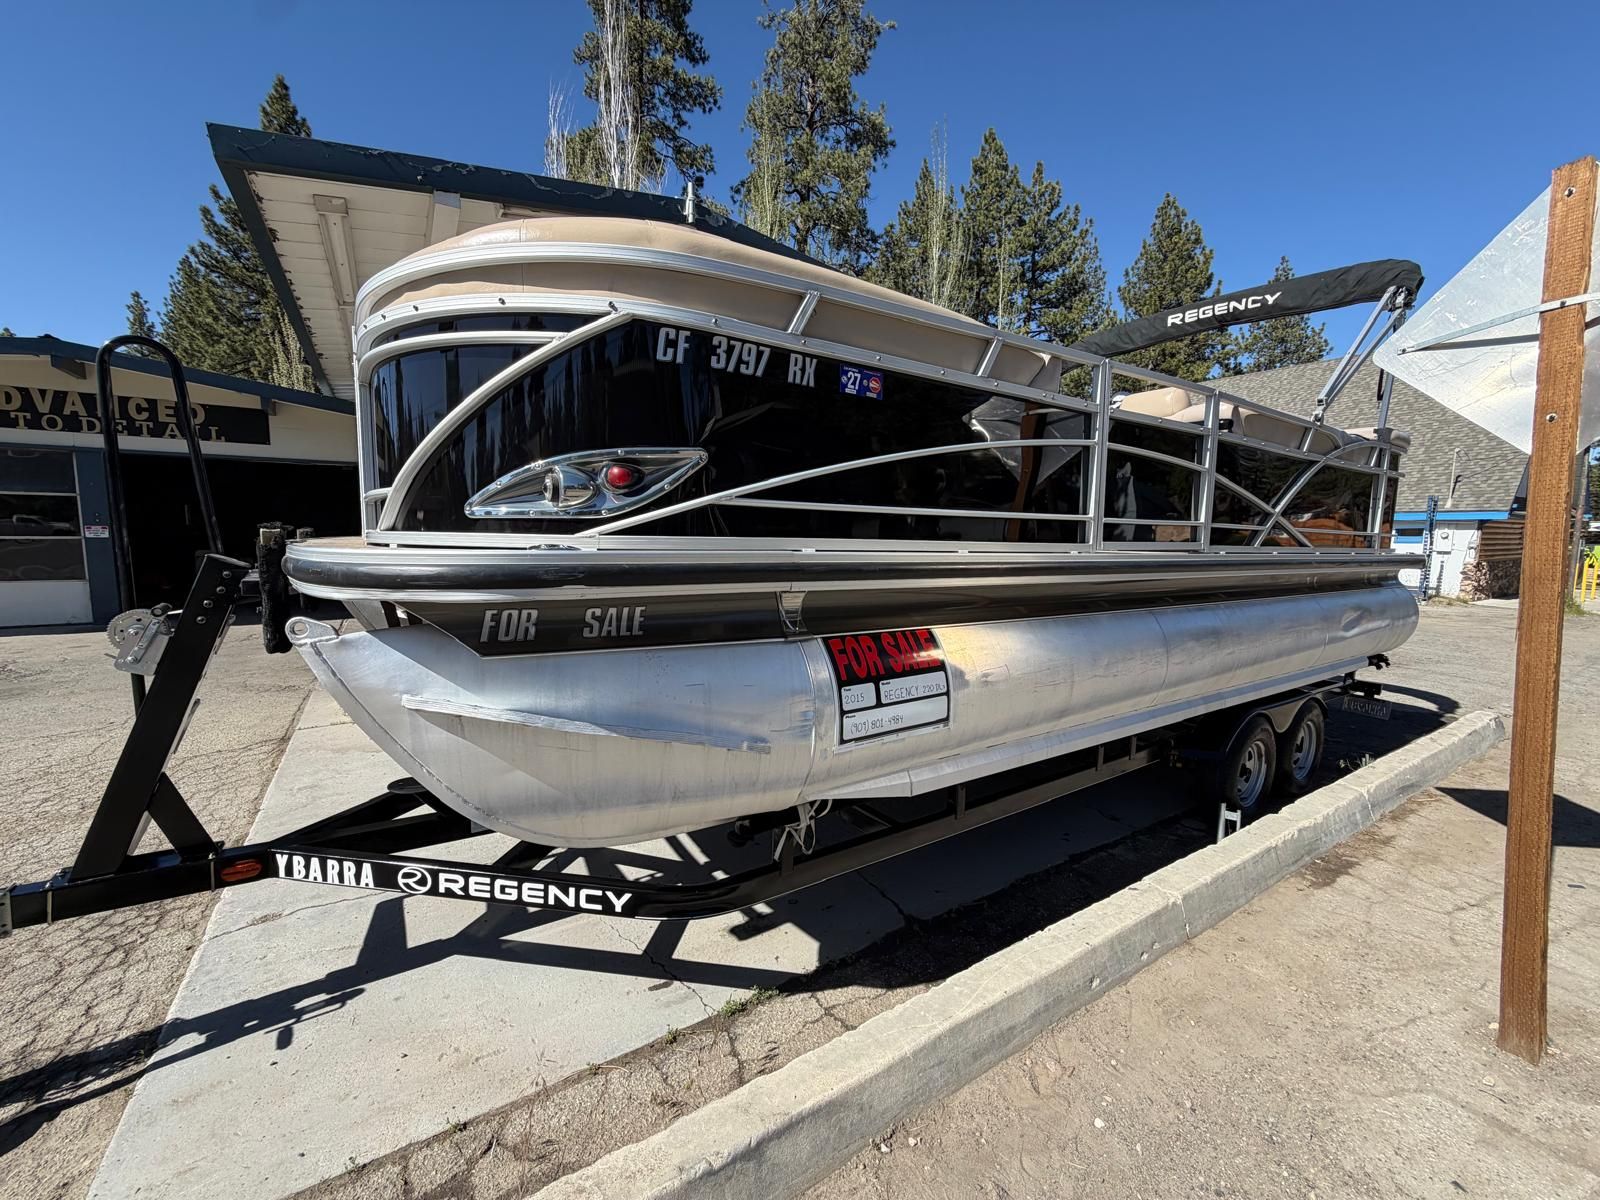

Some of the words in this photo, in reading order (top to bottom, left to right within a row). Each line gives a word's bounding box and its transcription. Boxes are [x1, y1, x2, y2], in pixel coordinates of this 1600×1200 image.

[1167, 291, 1282, 327] REGENCY
[656, 327, 691, 364] CF
[711, 335, 771, 377] 3797
[787, 353, 818, 388] RX
[847, 371, 861, 391] 27
[480, 608, 539, 643] FOR
[583, 606, 647, 638] SALE
[828, 635, 886, 681] FOR
[881, 629, 941, 673] SALE
[844, 692, 865, 704] 2015
[884, 685, 919, 701] REGENCY
[275, 853, 375, 888] YBARRA
[438, 873, 633, 913] REGENCY
